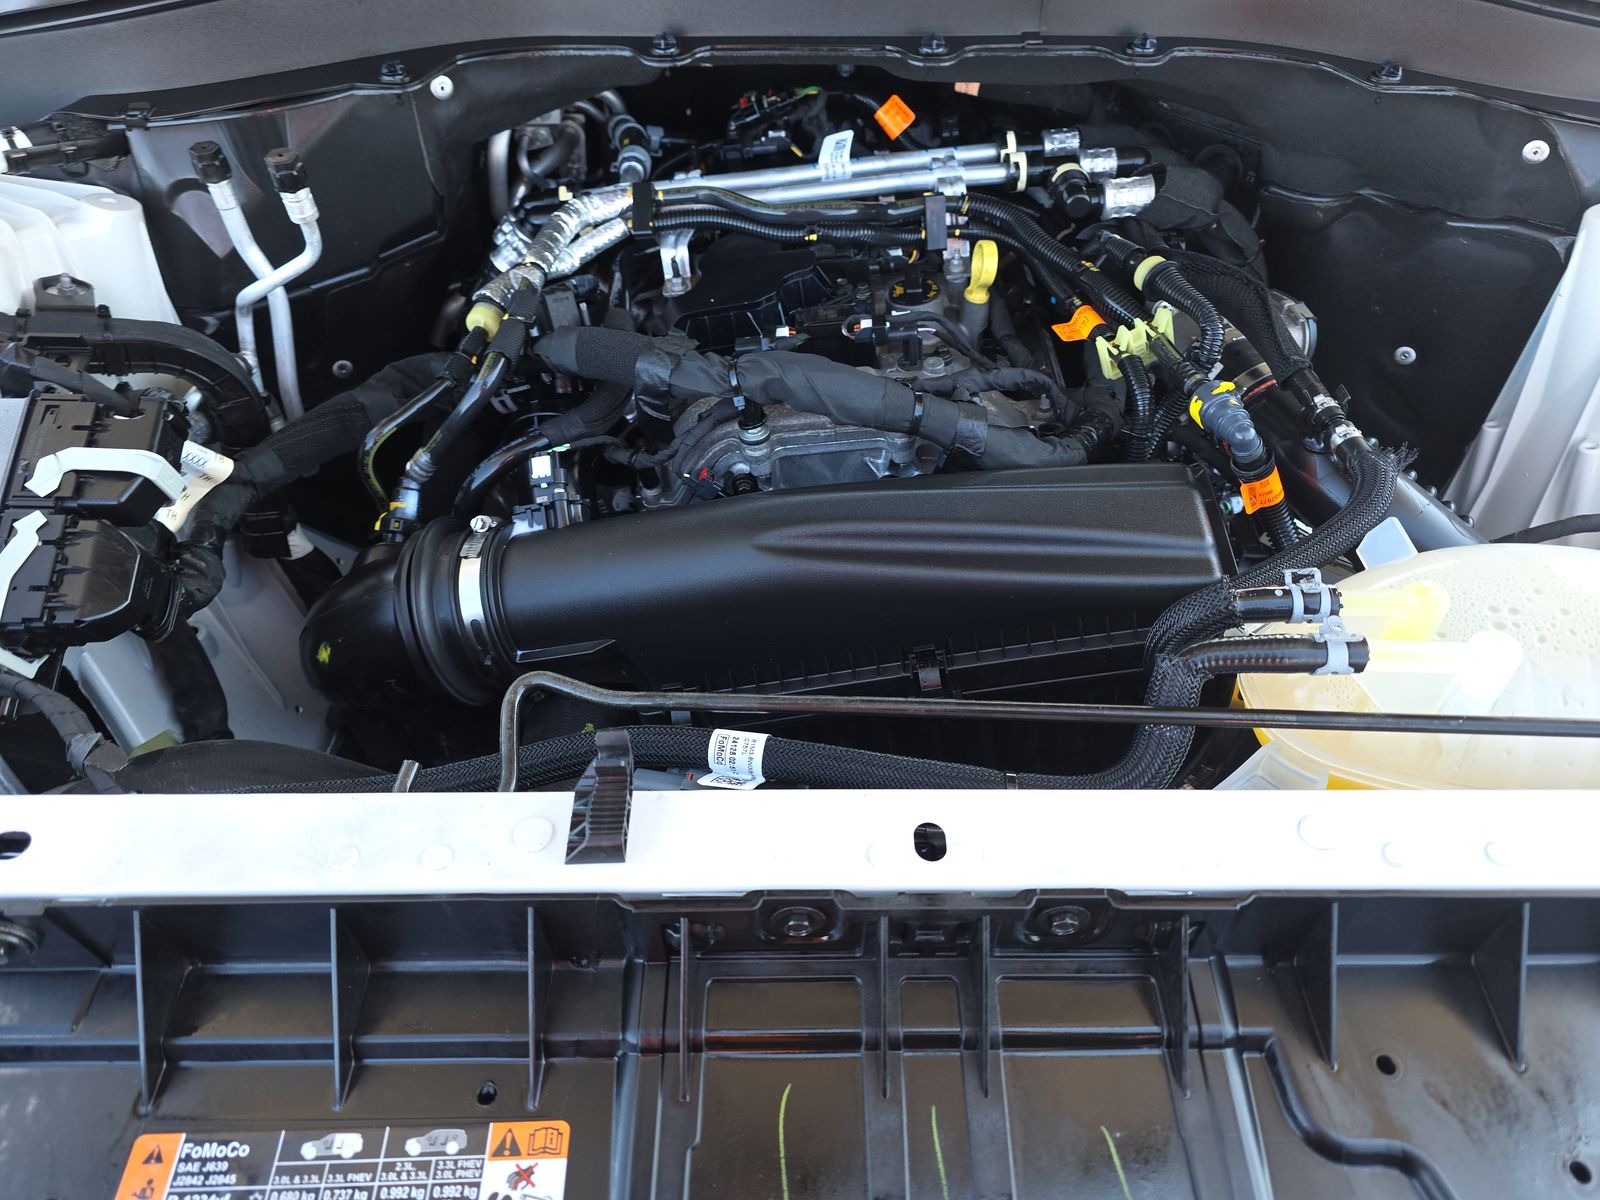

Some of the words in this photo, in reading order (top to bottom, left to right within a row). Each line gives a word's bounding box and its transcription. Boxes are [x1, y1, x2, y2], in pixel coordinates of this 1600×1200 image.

[716, 735, 727, 765] FoMoCo
[180, 1141, 251, 1159] FoMoCo
[177, 1161, 202, 1174] SAE
[202, 1160, 229, 1173] J639
[410, 1185, 426, 1200] kg
[463, 1184, 479, 1200] kg
